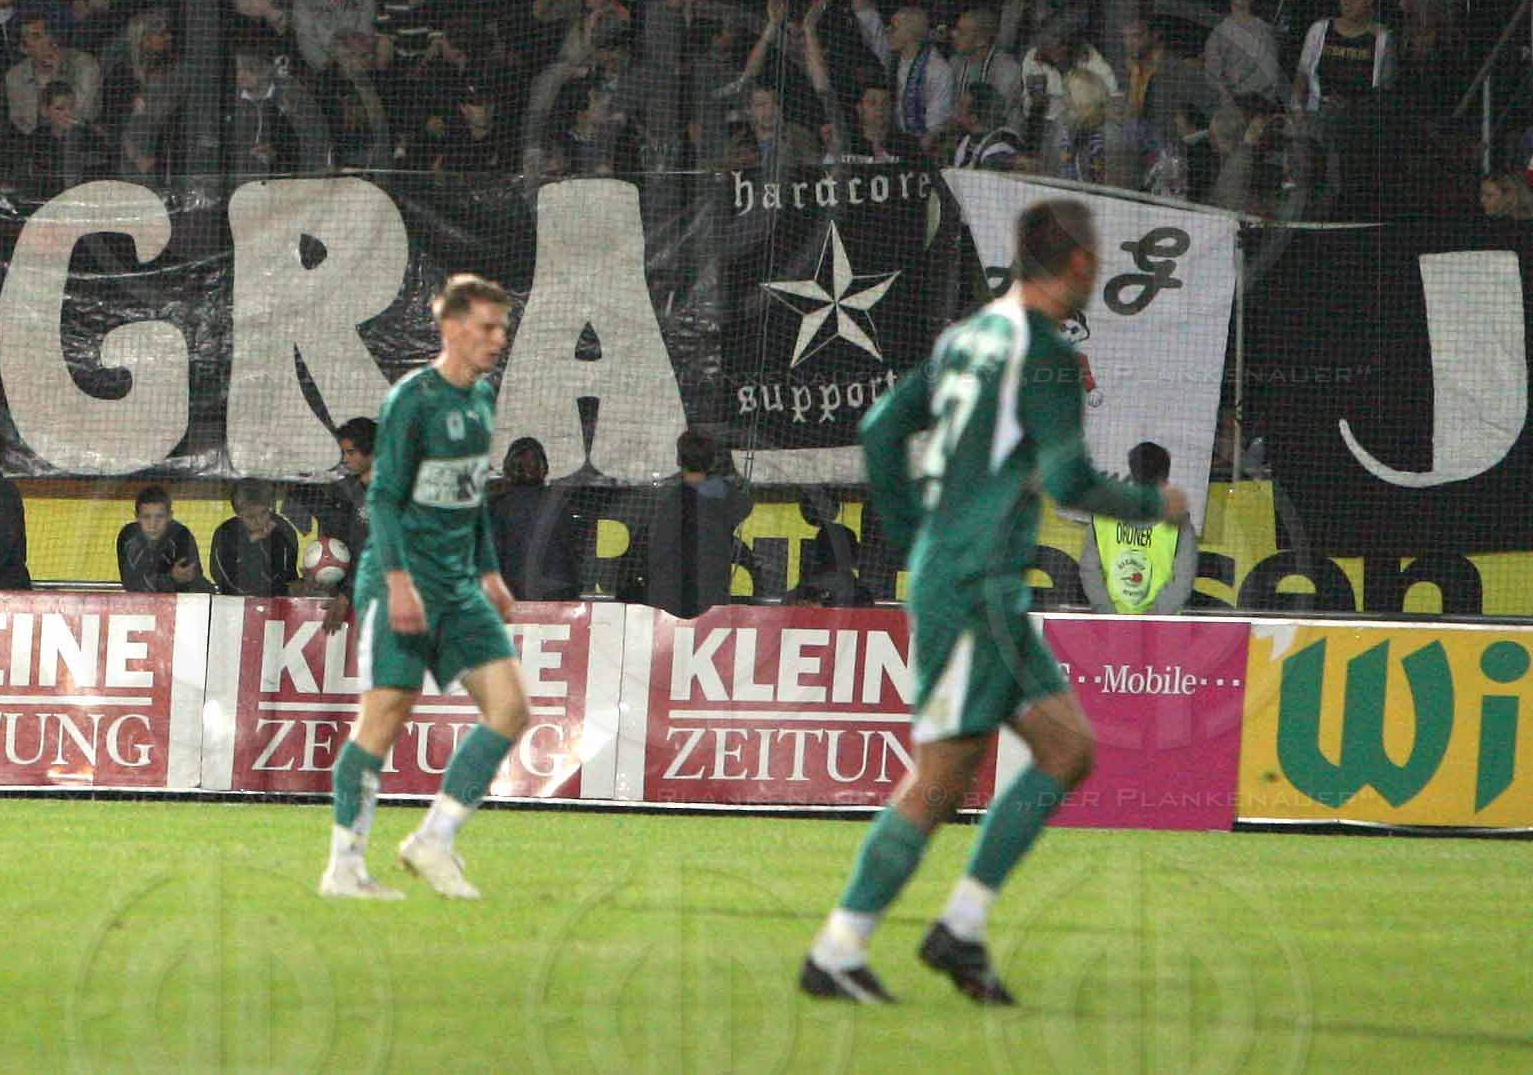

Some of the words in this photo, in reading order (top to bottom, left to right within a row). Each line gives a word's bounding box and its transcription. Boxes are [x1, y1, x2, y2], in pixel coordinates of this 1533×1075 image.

[731, 170, 932, 216] hardcore
[737, 369, 897, 423] support
[669, 626, 915, 705] KLEIN
[1101, 664, 1197, 695] Mobile
[661, 727, 915, 783] ZEITUN
